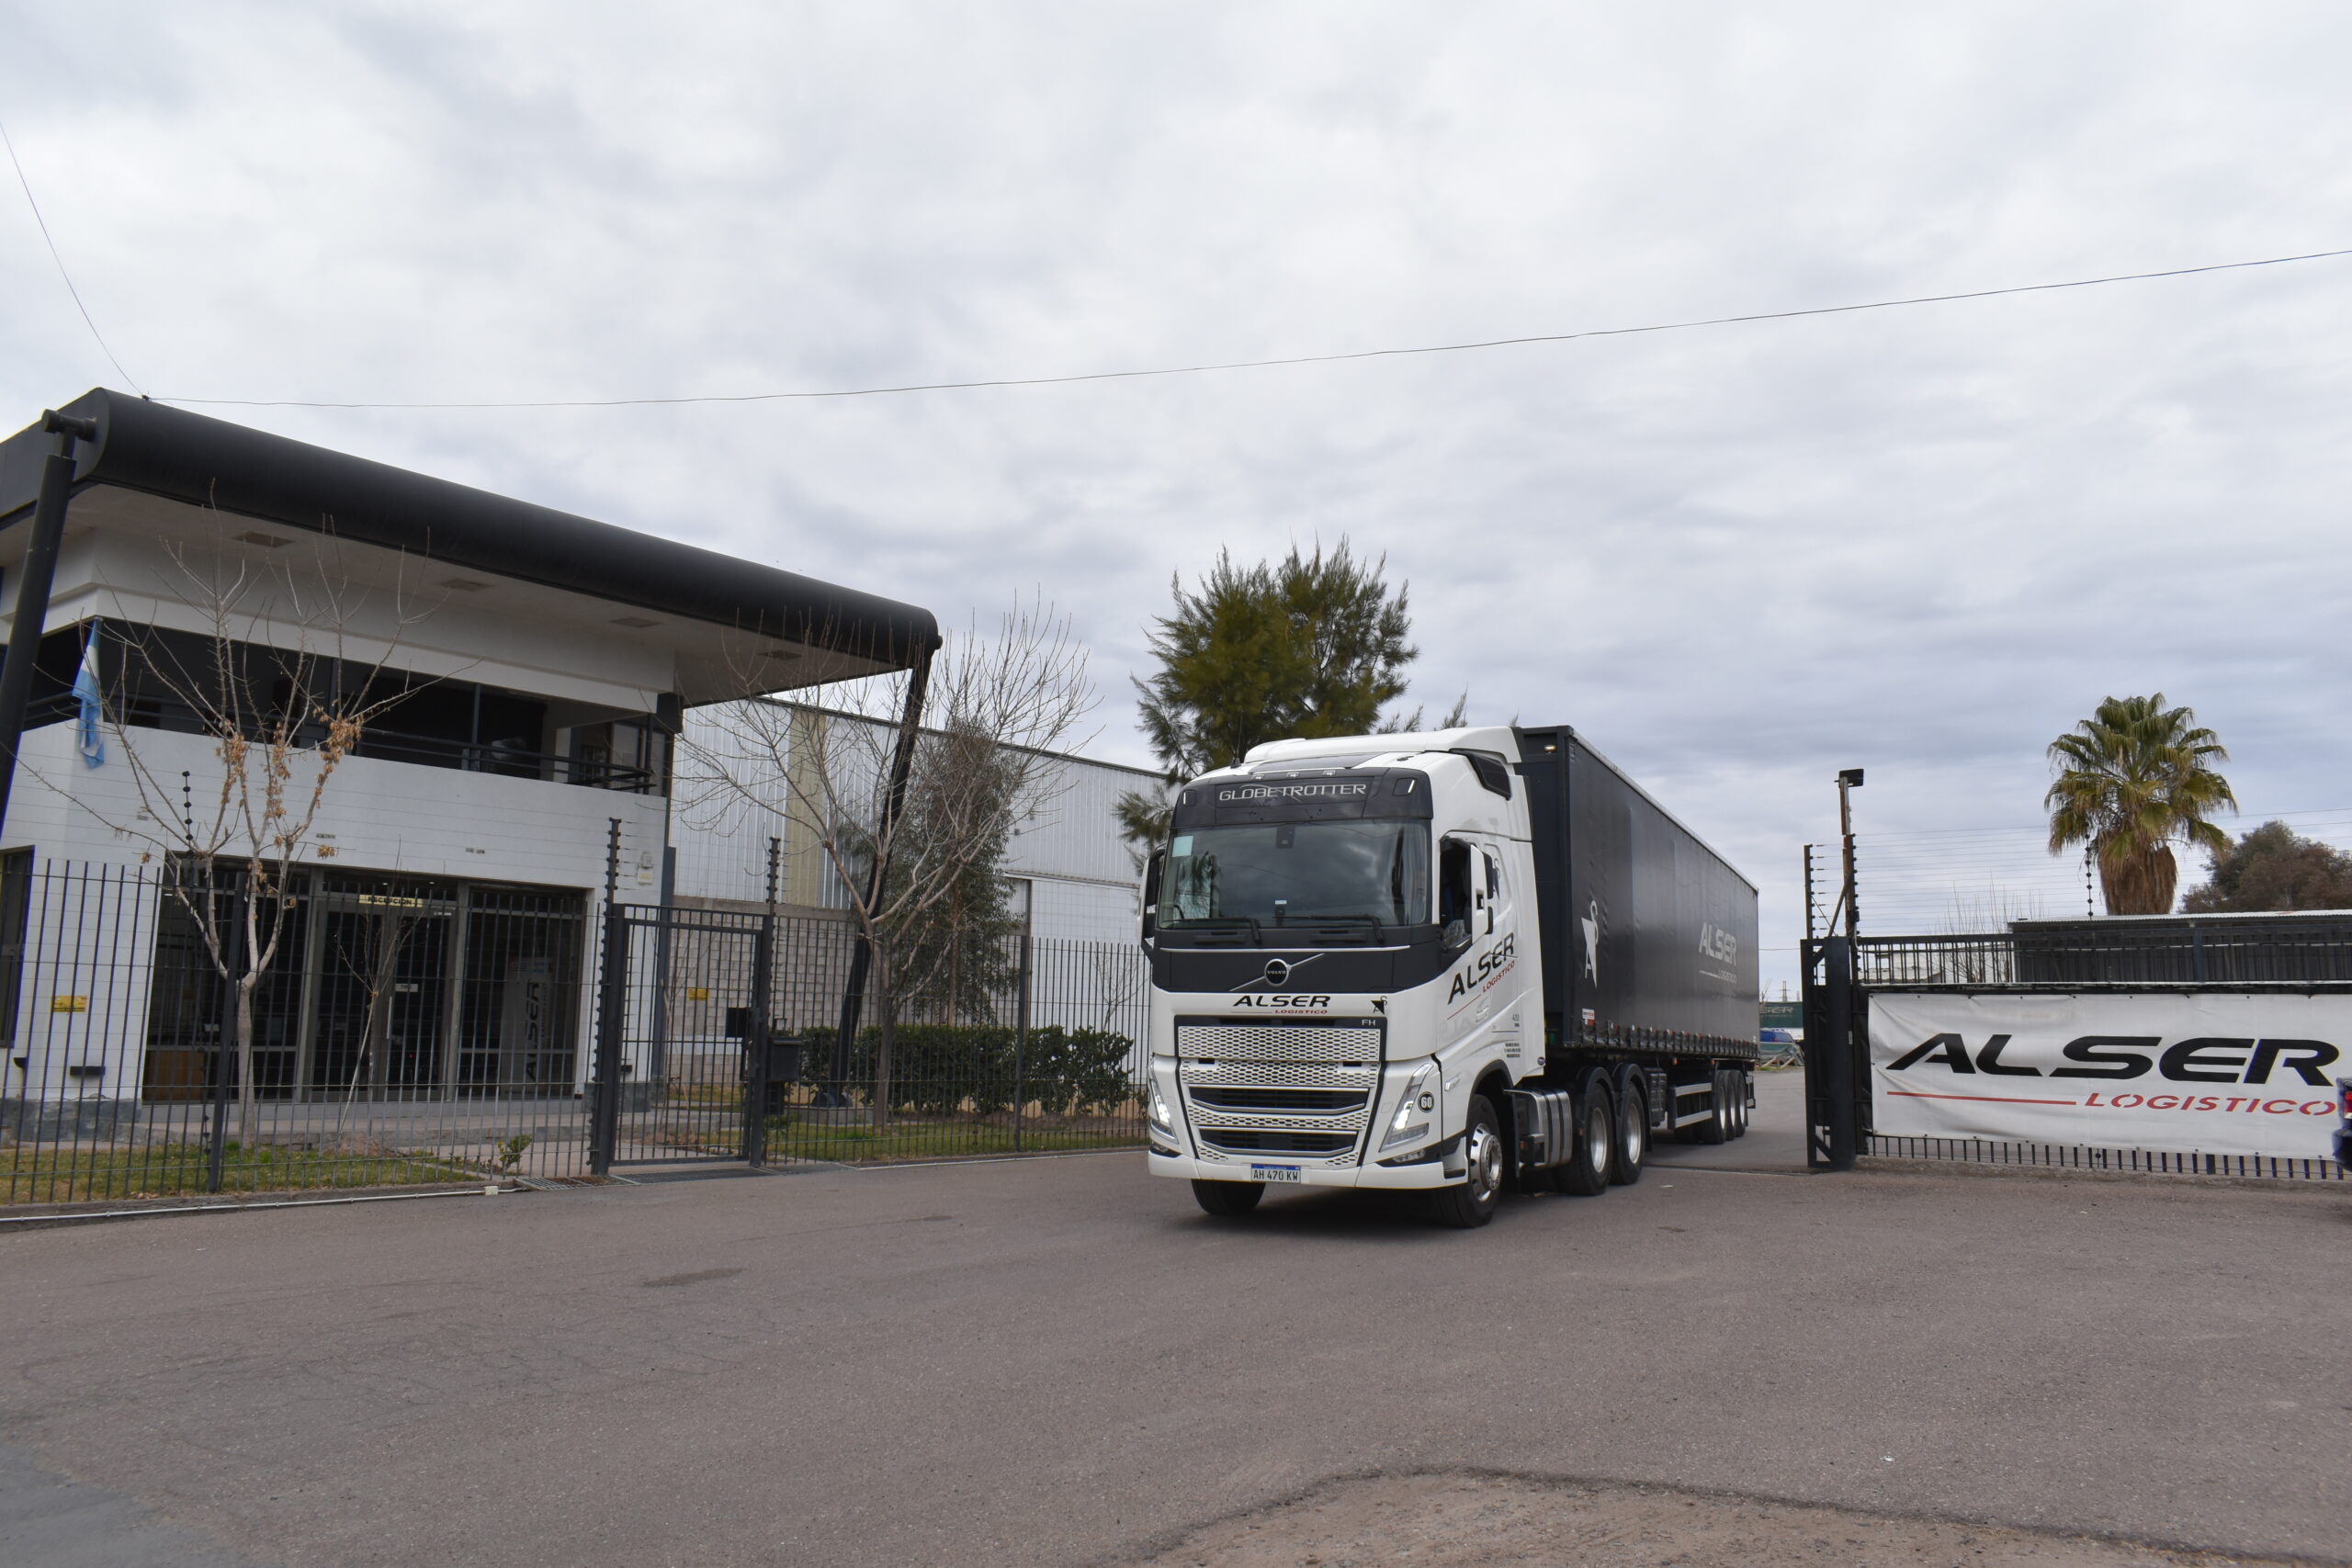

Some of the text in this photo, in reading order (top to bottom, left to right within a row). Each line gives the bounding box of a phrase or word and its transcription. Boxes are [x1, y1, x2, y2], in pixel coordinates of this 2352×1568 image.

[1219, 784, 1366, 801] GLOBETROTTER
[1699, 921, 1736, 966] ALSER
[1447, 932, 1514, 1005] ALSER
[1483, 960, 1515, 993] LOGISTICO
[1233, 995, 1331, 1008] ALSER
[1886, 1033, 2339, 1087] ALSER
[1420, 1096, 1432, 1108] 60
[2085, 1092, 2336, 1116] LOGISTICO
[1253, 1169, 1298, 1181] AH 470 KW
